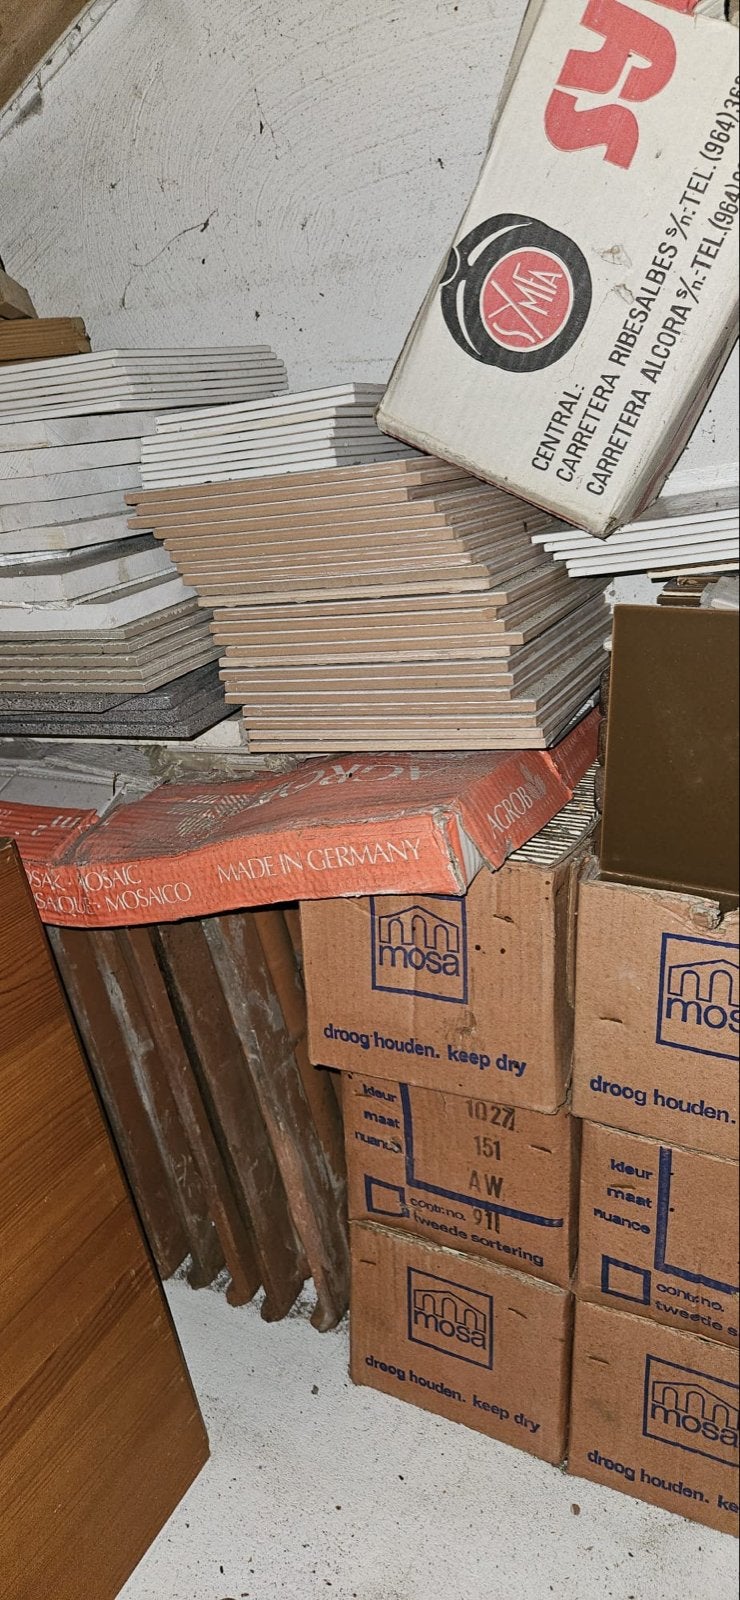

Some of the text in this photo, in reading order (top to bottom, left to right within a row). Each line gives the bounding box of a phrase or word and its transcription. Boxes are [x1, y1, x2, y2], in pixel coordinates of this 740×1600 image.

[543, 0, 696, 170] SY
[556, 374, 620, 482] CARRETERA
[608, 241, 678, 366] RIBESALBES
[586, 390, 651, 495] CARRETERA
[640, 305, 692, 384] ALCORA
[531, 384, 585, 471] CENTRAL:
[486, 786, 533, 839] AGROB
[218, 838, 421, 883] MADE IN GERMANY
[106, 882, 192, 912] MOSAICO
[378, 945, 460, 976] mosa
[324, 1023, 527, 1077] droog houden. keep dry
[364, 1109, 400, 1129] maat
[590, 1075, 736, 1124] droog houden.
[474, 1135, 501, 1160] 151
[610, 1158, 653, 1180] kleur
[593, 1207, 651, 1234] nuance
[607, 1187, 652, 1209] maat
[414, 1210, 544, 1267] tweede sortering
[414, 1309, 487, 1349] mosa
[655, 1301, 723, 1331] tweede
[365, 1356, 541, 1433] droog houden. keep dry
[651, 1403, 739, 1448] mosa
[588, 1450, 635, 1482] droog
[640, 1468, 709, 1503] houden.
